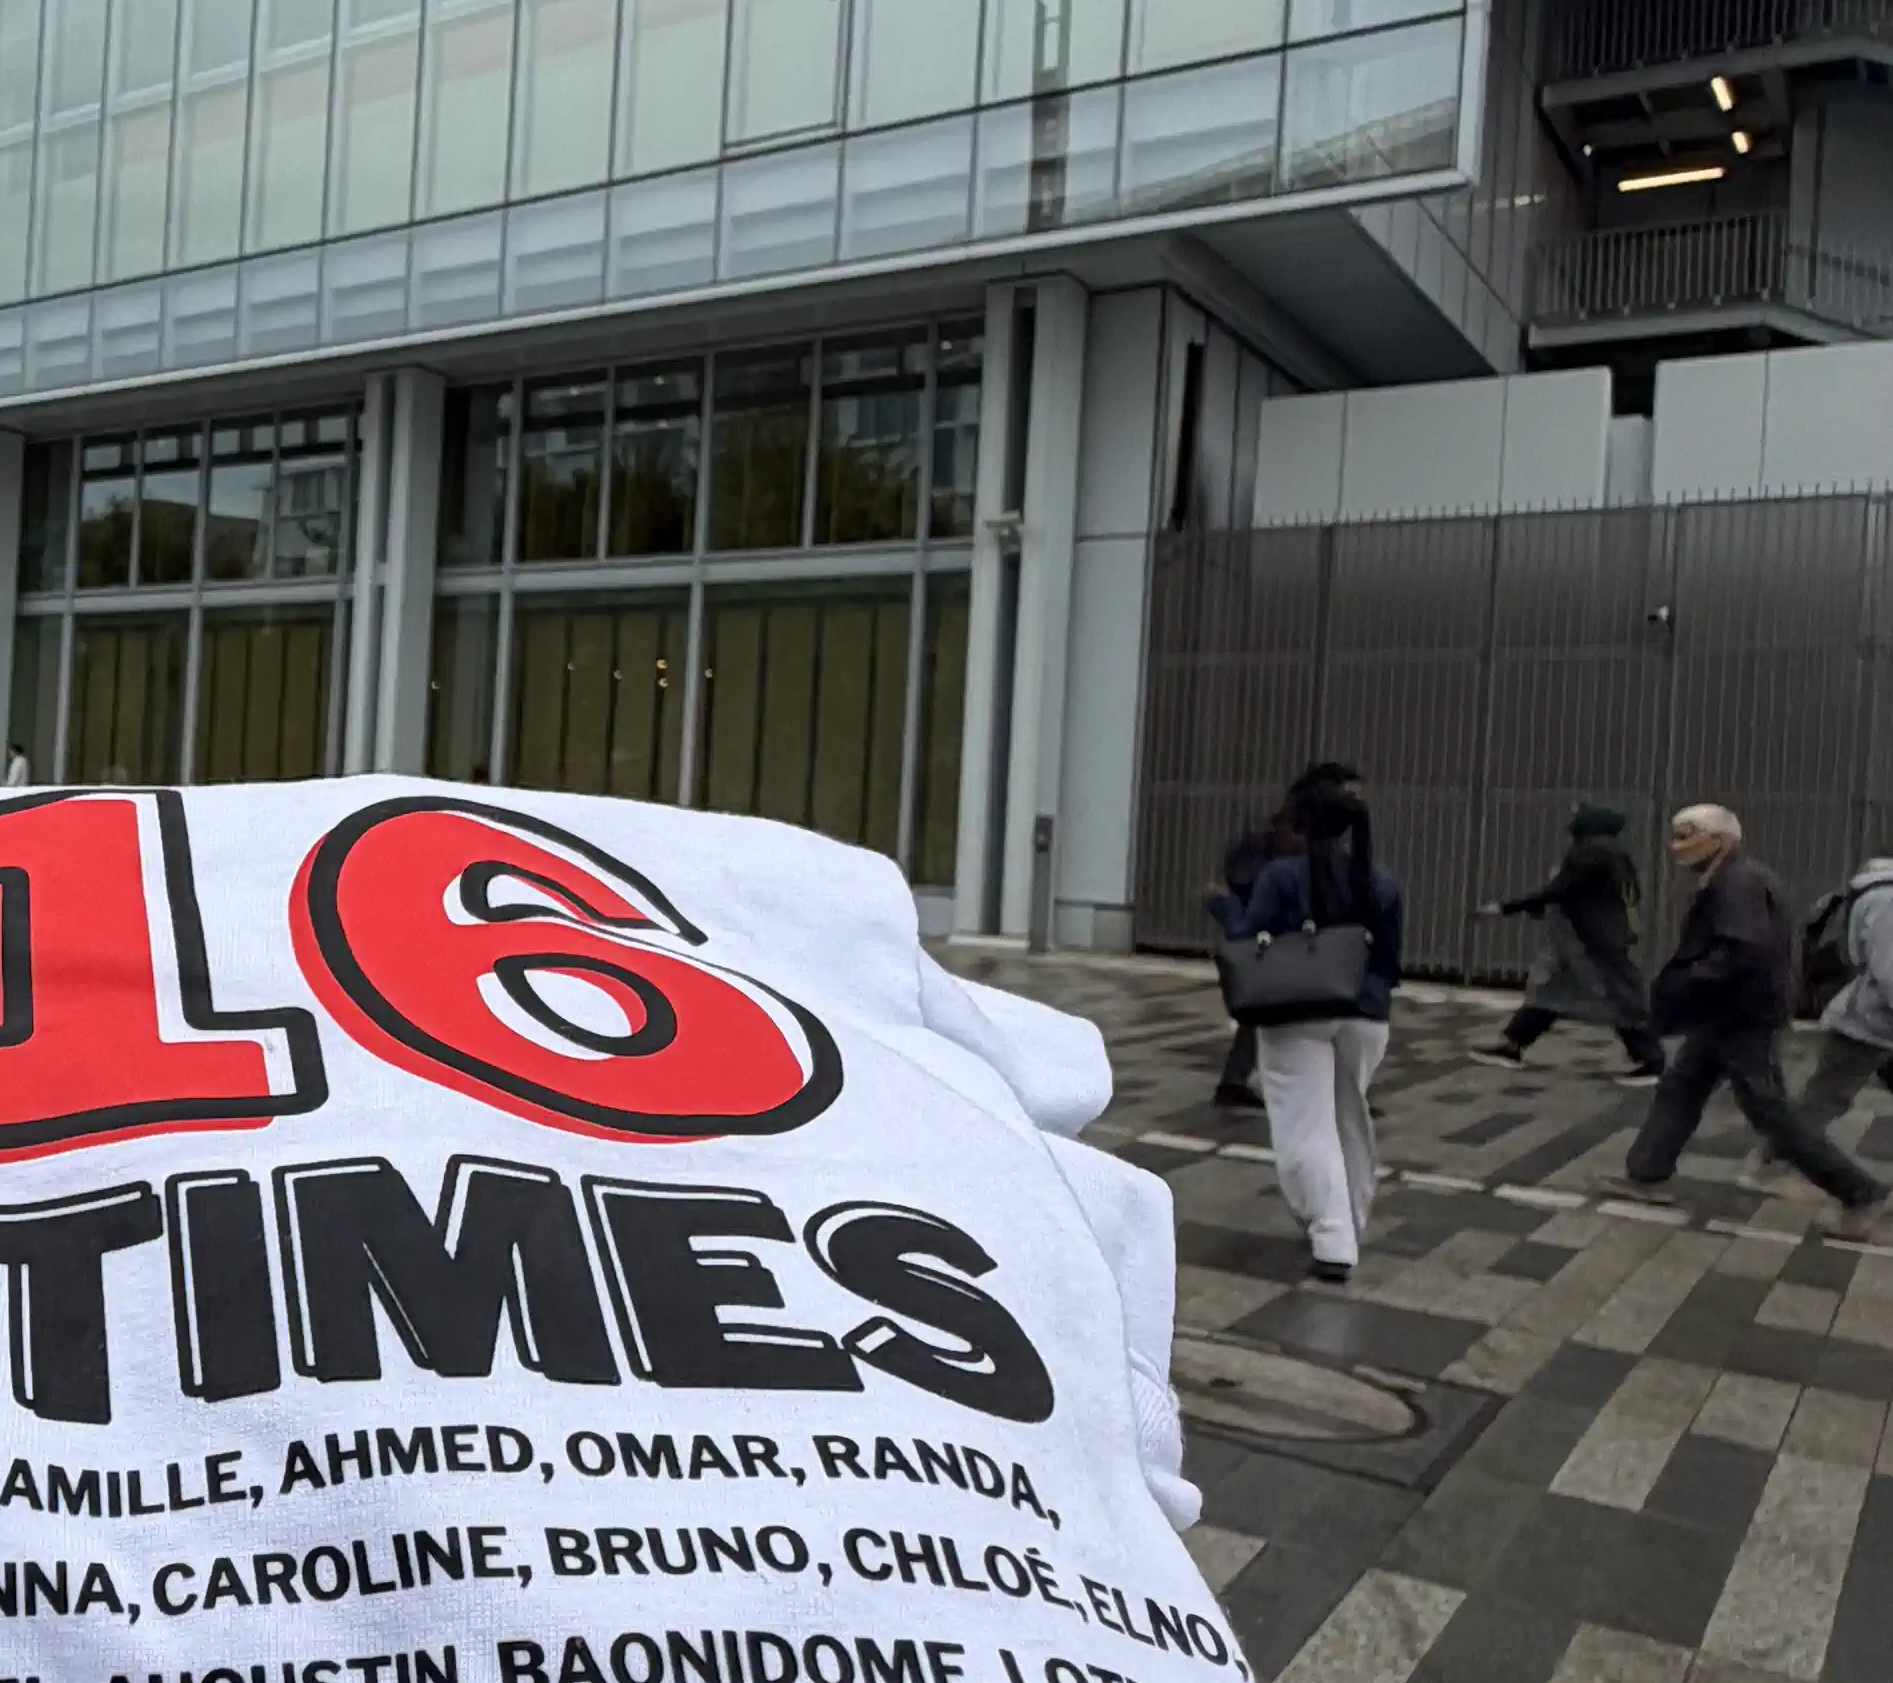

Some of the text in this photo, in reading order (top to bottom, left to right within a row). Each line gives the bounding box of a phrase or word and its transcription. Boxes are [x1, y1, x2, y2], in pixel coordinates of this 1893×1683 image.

[278, 1423, 555, 1496] AHMED,
[565, 1430, 807, 1487] OMAR,
[811, 1434, 1062, 1532] RANDA,
[151, 1525, 534, 1617] CAROLINE,
[543, 1524, 834, 1588] BRUNO,
[842, 1527, 1089, 1623] CHLOÉ,
[1080, 1574, 1250, 1682] ELNO,
